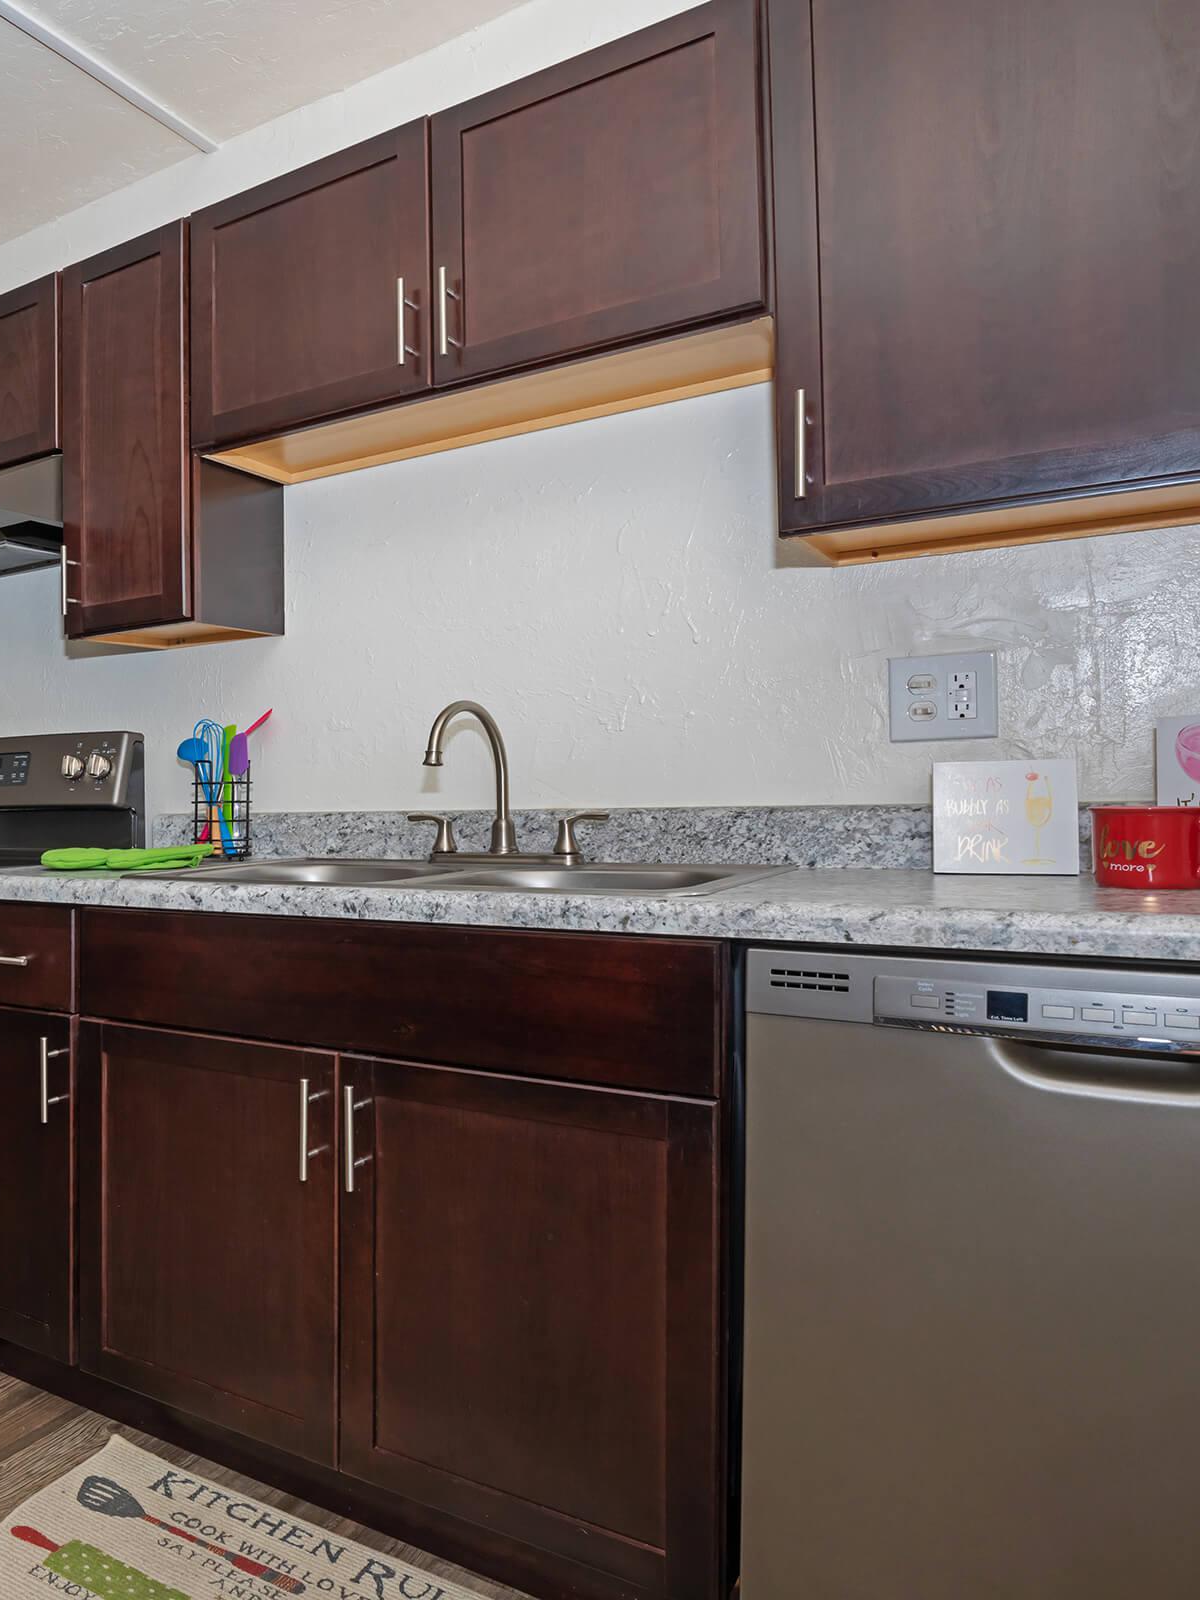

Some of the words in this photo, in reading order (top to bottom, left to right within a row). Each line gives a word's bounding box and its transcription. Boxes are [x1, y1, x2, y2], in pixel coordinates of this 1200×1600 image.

[1099, 824, 1166, 861] love
[1110, 862, 1145, 872] more
[147, 1470, 349, 1564] KITCHEN
[169, 1511, 234, 1545] COOK
[238, 1541, 298, 1574] WITH
[28, 1564, 96, 1600] ENJOY
[157, 1537, 202, 1560] SAY
[201, 1558, 288, 1600] PLEASE
